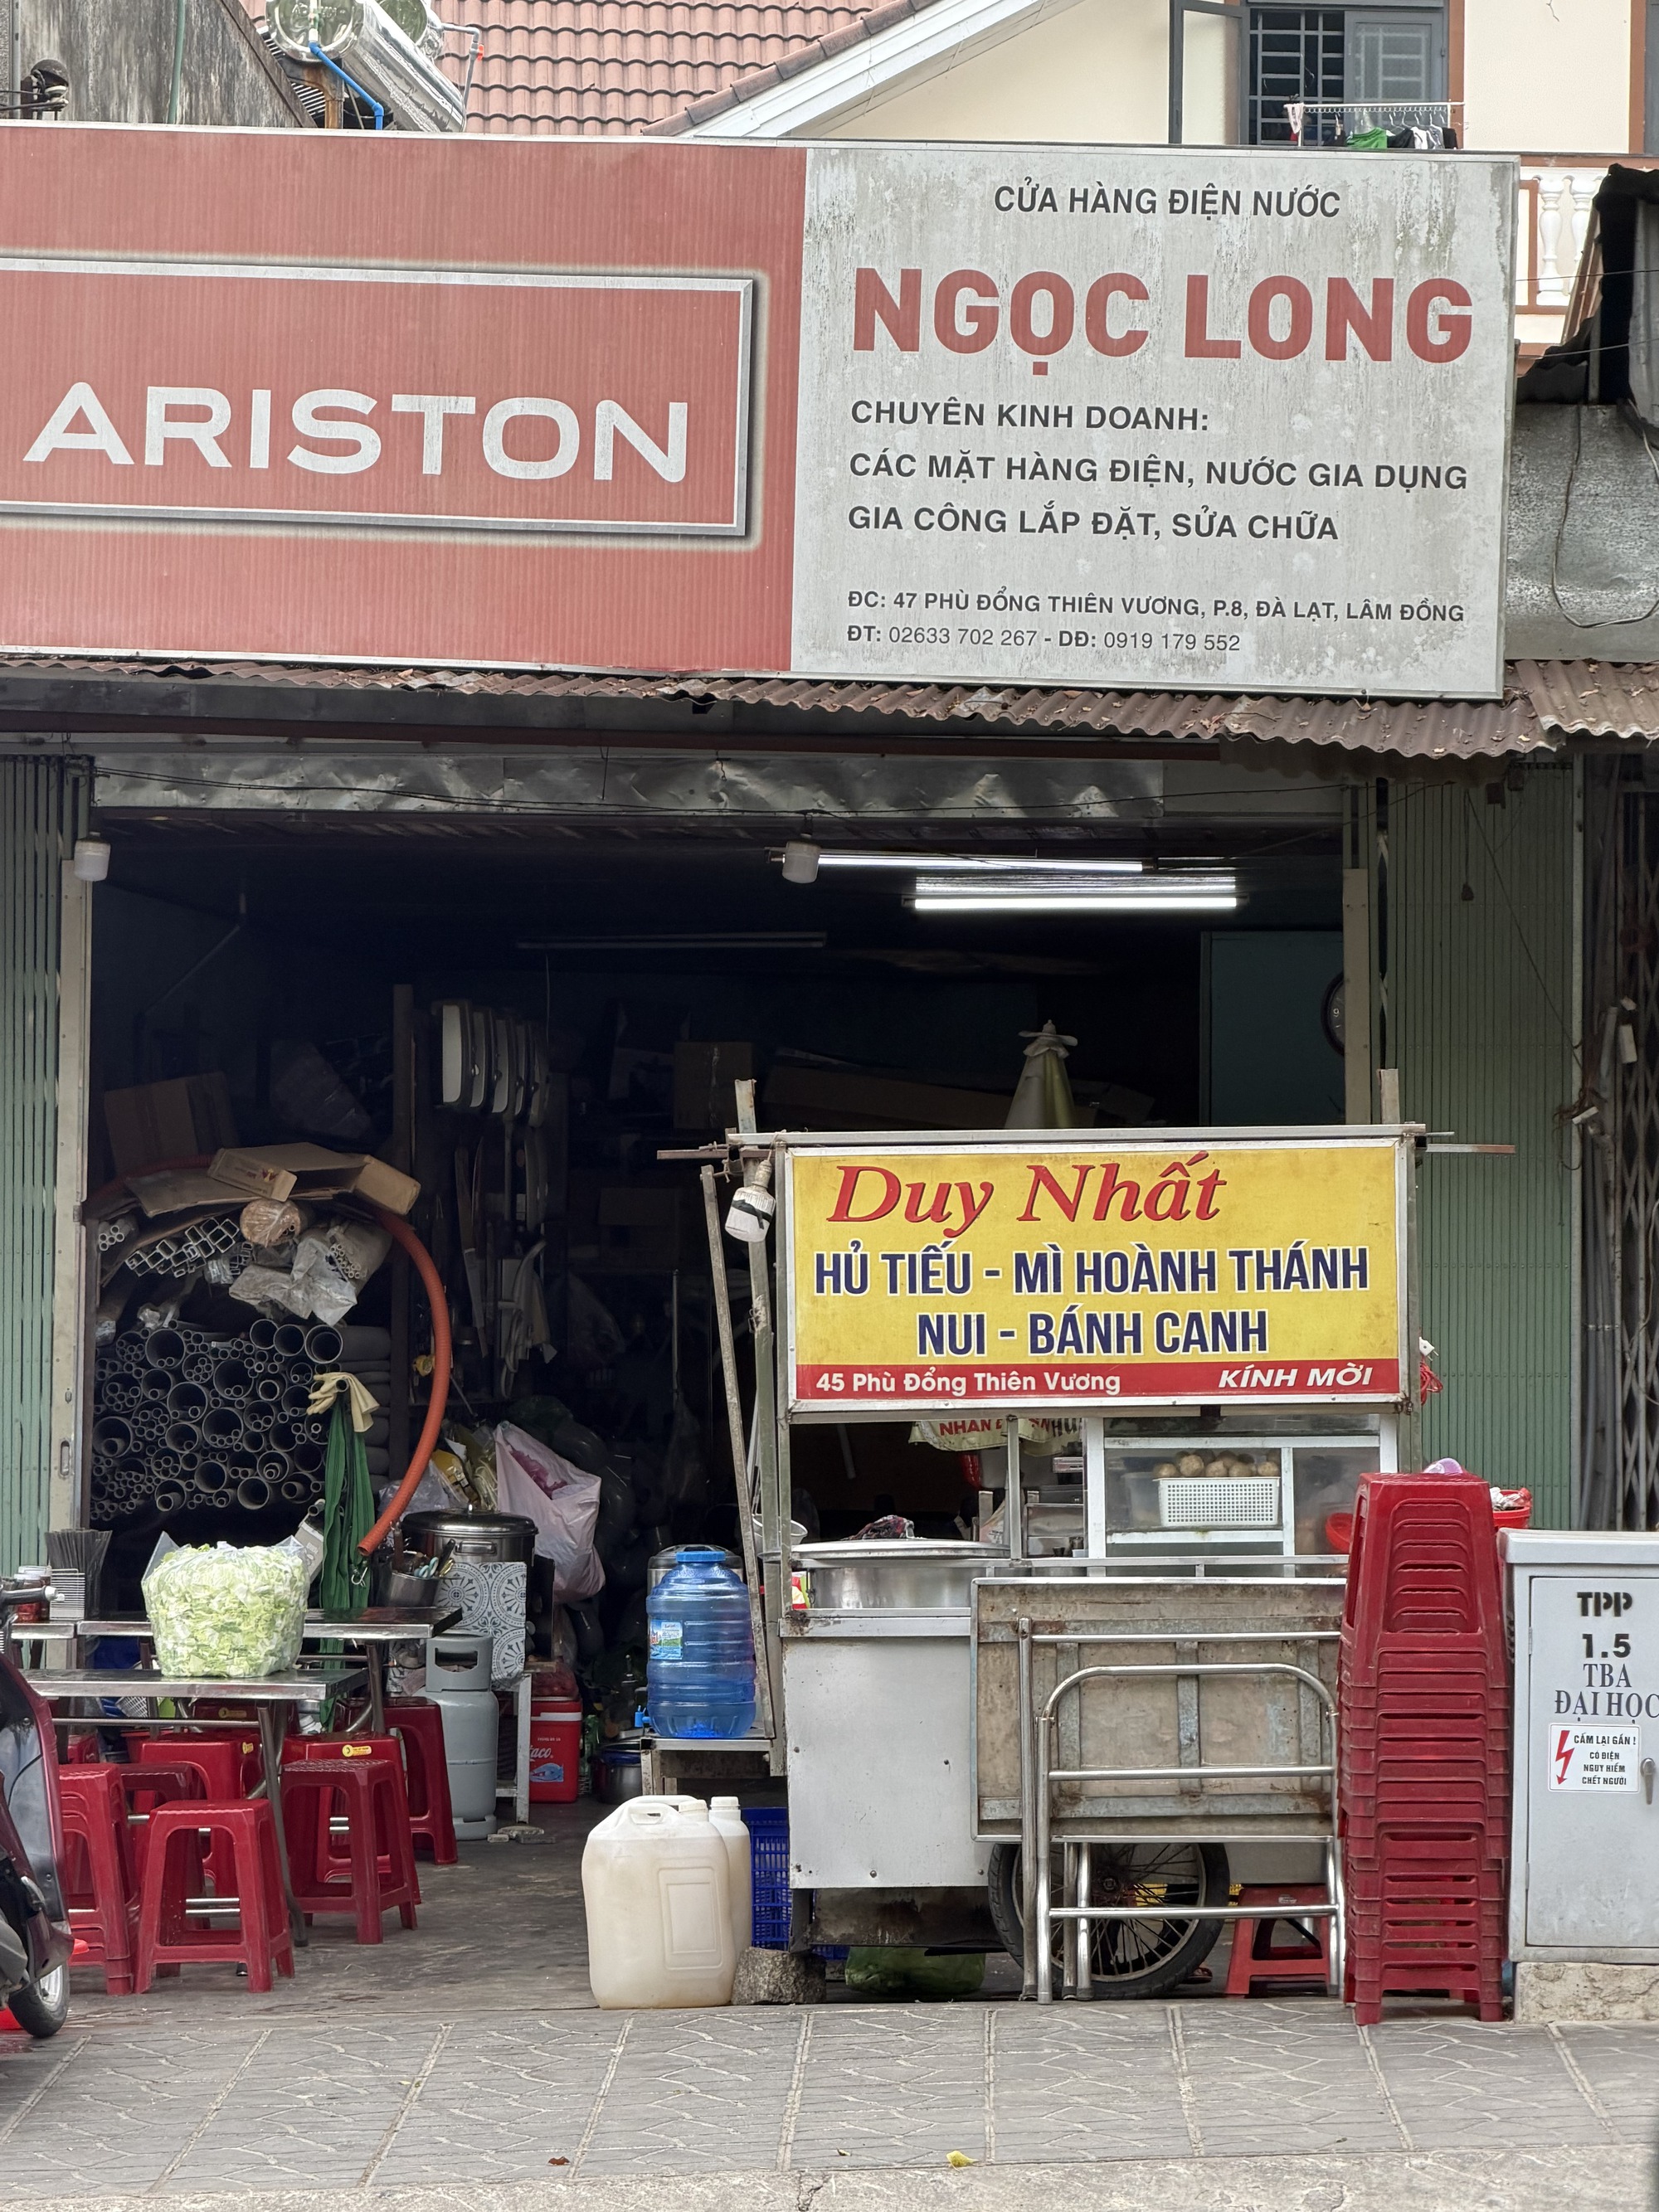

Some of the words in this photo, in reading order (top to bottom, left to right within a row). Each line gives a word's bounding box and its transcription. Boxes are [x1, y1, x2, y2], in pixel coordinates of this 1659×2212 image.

[995, 176, 1058, 214] CỬA
[1069, 181, 1157, 214] HÀNG
[1168, 184, 1241, 221] ĐIỆN
[1253, 185, 1340, 218] NƯỚC
[854, 268, 1150, 376] NGỌC
[1185, 275, 1473, 363] LONG
[851, 396, 984, 425] CHUYÊN
[997, 404, 1073, 428] KINH
[1086, 406, 1209, 430] DOANH:
[22, 381, 688, 483] ARISTON
[850, 448, 917, 477] CÁC
[928, 449, 995, 484] MẶT
[1007, 451, 1097, 482] HÀNG
[1109, 454, 1194, 488] ĐIỆN,
[1206, 456, 1297, 486] NƯỚC
[1308, 464, 1364, 487] GIA
[1375, 464, 1467, 493] DỤNG
[848, 506, 903, 530] GIA
[914, 502, 1006, 532] CÔNG
[1019, 500, 1079, 534] LẮP
[1092, 506, 1160, 540] ĐẶT,
[1172, 505, 1237, 537] SỬA
[1248, 511, 1338, 540] CHỮA
[848, 591, 886, 608] ĐC:
[893, 592, 917, 609] 47
[925, 589, 969, 610] PHÙ
[977, 586, 1040, 612] ĐỔNG
[1048, 592, 1113, 614] THIÊN
[1121, 596, 1205, 618] VƯƠNG,
[1214, 600, 1248, 620] P.8,
[1256, 596, 1286, 617] ĐÀ
[1293, 601, 1338, 622] LẠT,
[1346, 599, 1391, 620] LÂM
[1400, 598, 1464, 622] ĐỒNG
[848, 625, 881, 642] ĐT:
[889, 626, 950, 644] 02633
[958, 628, 994, 645] 702
[1000, 630, 1037, 646] 267
[1058, 630, 1096, 647] DĐ:
[1104, 632, 1152, 649] 0919
[1161, 633, 1196, 650] 179
[1204, 634, 1240, 651] 552
[827, 1164, 994, 1238] Duy
[1016, 1150, 1227, 1223] Nhất
[815, 1238, 868, 1296] HỦ
[880, 1240, 971, 1295] TIẾU
[985, 1267, 1000, 1279] -
[1014, 1242, 1063, 1295] MÌ
[1076, 1241, 1216, 1294] HOÀNH
[1228, 1238, 1369, 1291] THÁNH
[917, 1311, 985, 1356] NUI
[999, 1330, 1015, 1339] -
[1029, 1305, 1141, 1355] BÁNH
[1155, 1309, 1267, 1352] CANH
[816, 1373, 844, 1391] 45
[853, 1372, 895, 1392] Phù
[903, 1366, 966, 1396] Đổng
[974, 1370, 1036, 1391] Thiên
[1044, 1371, 1121, 1395] Vương
[1219, 1364, 1298, 1388] KÍNH
[1306, 1362, 1373, 1386] MỜI
[1577, 1592, 1632, 1616] TPP
[1582, 1633, 1631, 1658] 1.5
[1583, 1663, 1632, 1688] TBA
[1554, 1689, 1599, 1722] ĐẠI
[1606, 1692, 1659, 1724] HỌC
[1574, 1733, 1593, 1743] CẤM
[1596, 1736, 1609, 1746] LẠI
